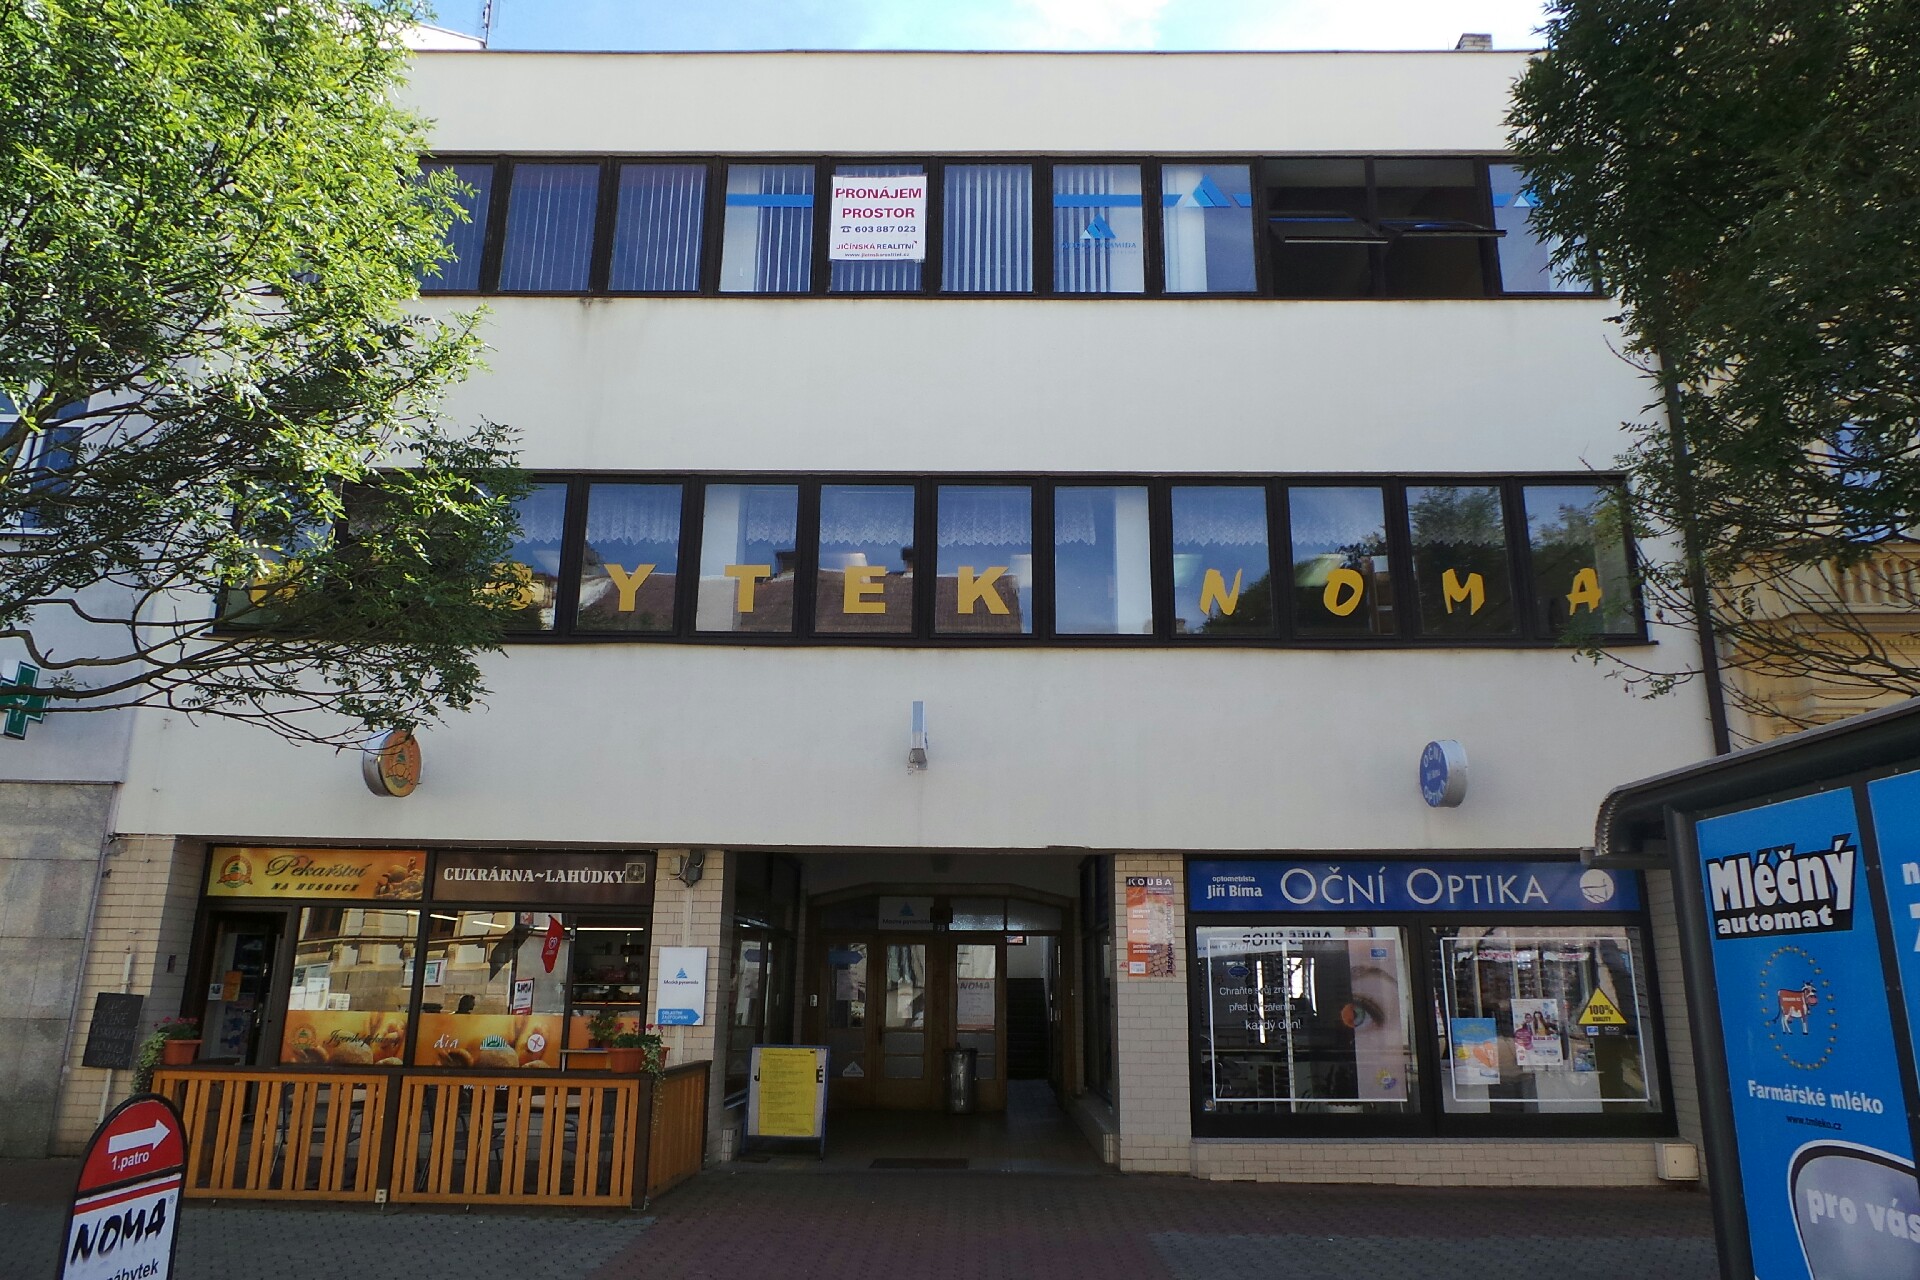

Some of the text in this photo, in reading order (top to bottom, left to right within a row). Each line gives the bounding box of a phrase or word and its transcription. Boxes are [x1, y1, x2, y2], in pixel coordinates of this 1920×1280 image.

[835, 186, 922, 199] PRONÁJEM
[842, 208, 915, 218] PROSTOR
[265, 854, 372, 878] Pekařství
[1708, 839, 1854, 911] Mléčný
[271, 882, 288, 891] NA
[1127, 878, 1172, 886] KOUBA
[1212, 875, 1256, 883] optometrista
[1280, 866, 1549, 905] OČNÍ OPTIKA
[1206, 883, 1263, 900] Jiří Bíma
[1717, 904, 1834, 934] automat
[1229, 1002, 1248, 1013] před
[1588, 1004, 1614, 1015] 100%
[433, 1033, 459, 1050] dia
[1748, 1080, 1884, 1114] Farmářské mléko
[111, 1151, 150, 1172] 1.patro
[1806, 1189, 1858, 1225] pro
[69, 1197, 167, 1267] NOMA
[107, 1258, 160, 1280] ábytek
